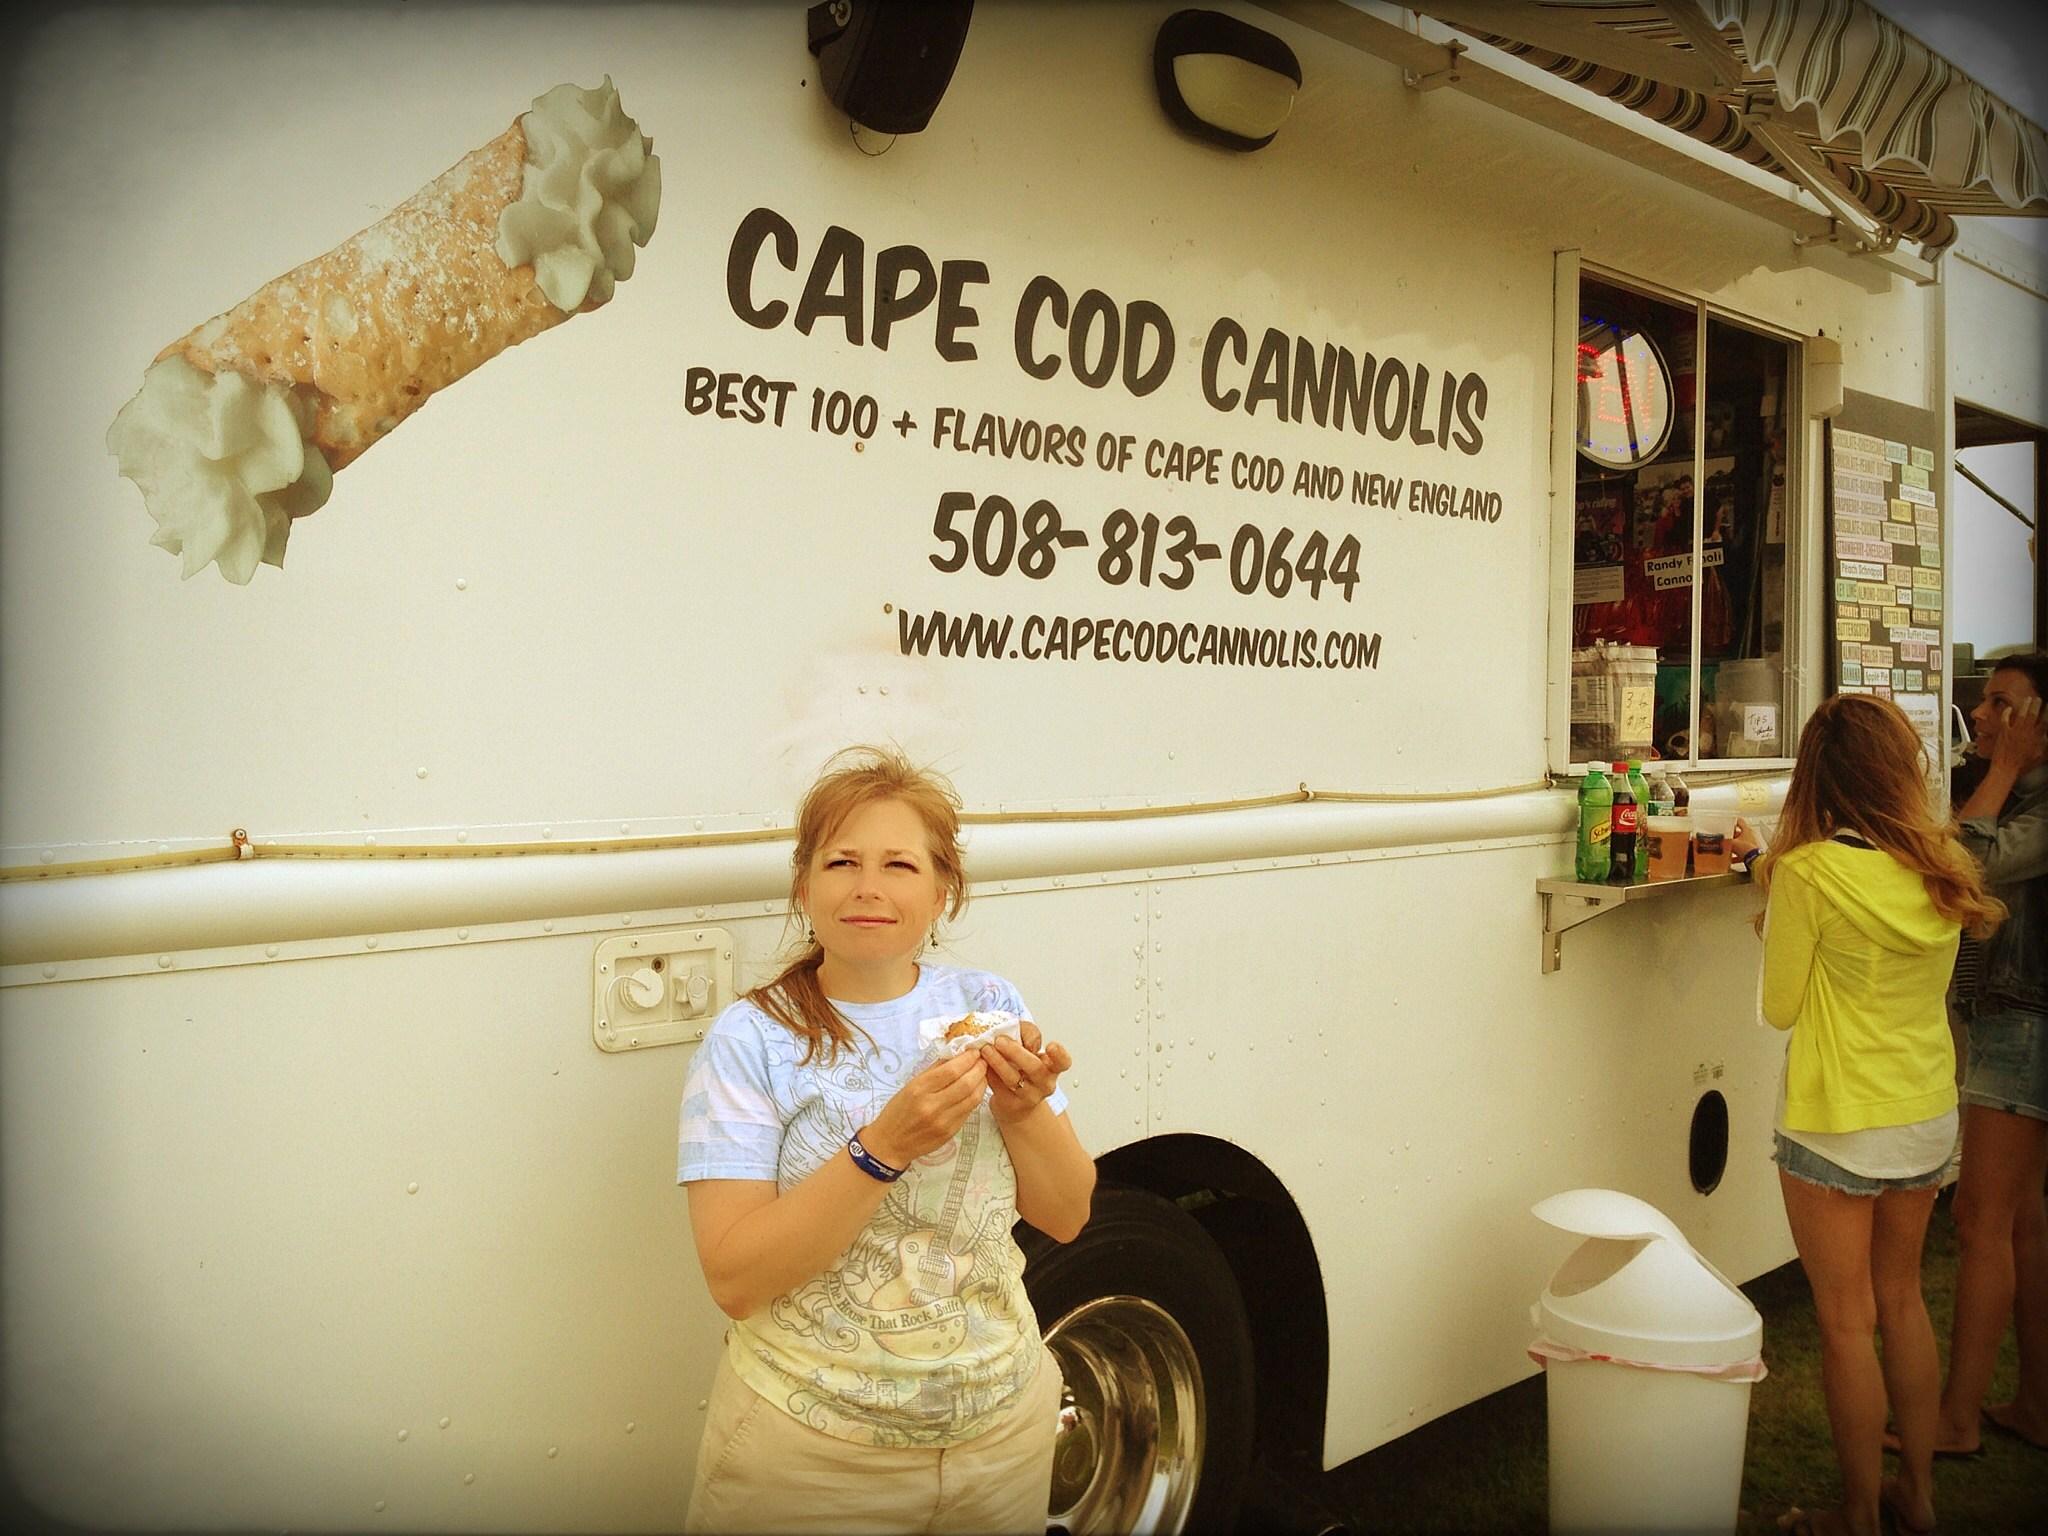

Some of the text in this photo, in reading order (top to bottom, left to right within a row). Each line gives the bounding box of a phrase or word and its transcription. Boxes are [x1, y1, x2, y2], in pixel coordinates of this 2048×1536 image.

[726, 207, 1488, 456] CAPE COD CANNOLIS
[684, 367, 1503, 524] BEST 100 + FLAVORS OF CAPE COD AND NEW ENGLAND
[928, 491, 1361, 603] 508-813-0644
[1646, 550, 1722, 573] Randy Fnoli
[1656, 573, 1693, 587] Canno
[898, 609, 1382, 670] WWW.CAPECODCANNOLIS.COM
[829, 1275, 960, 1331] The House That Rock Built
